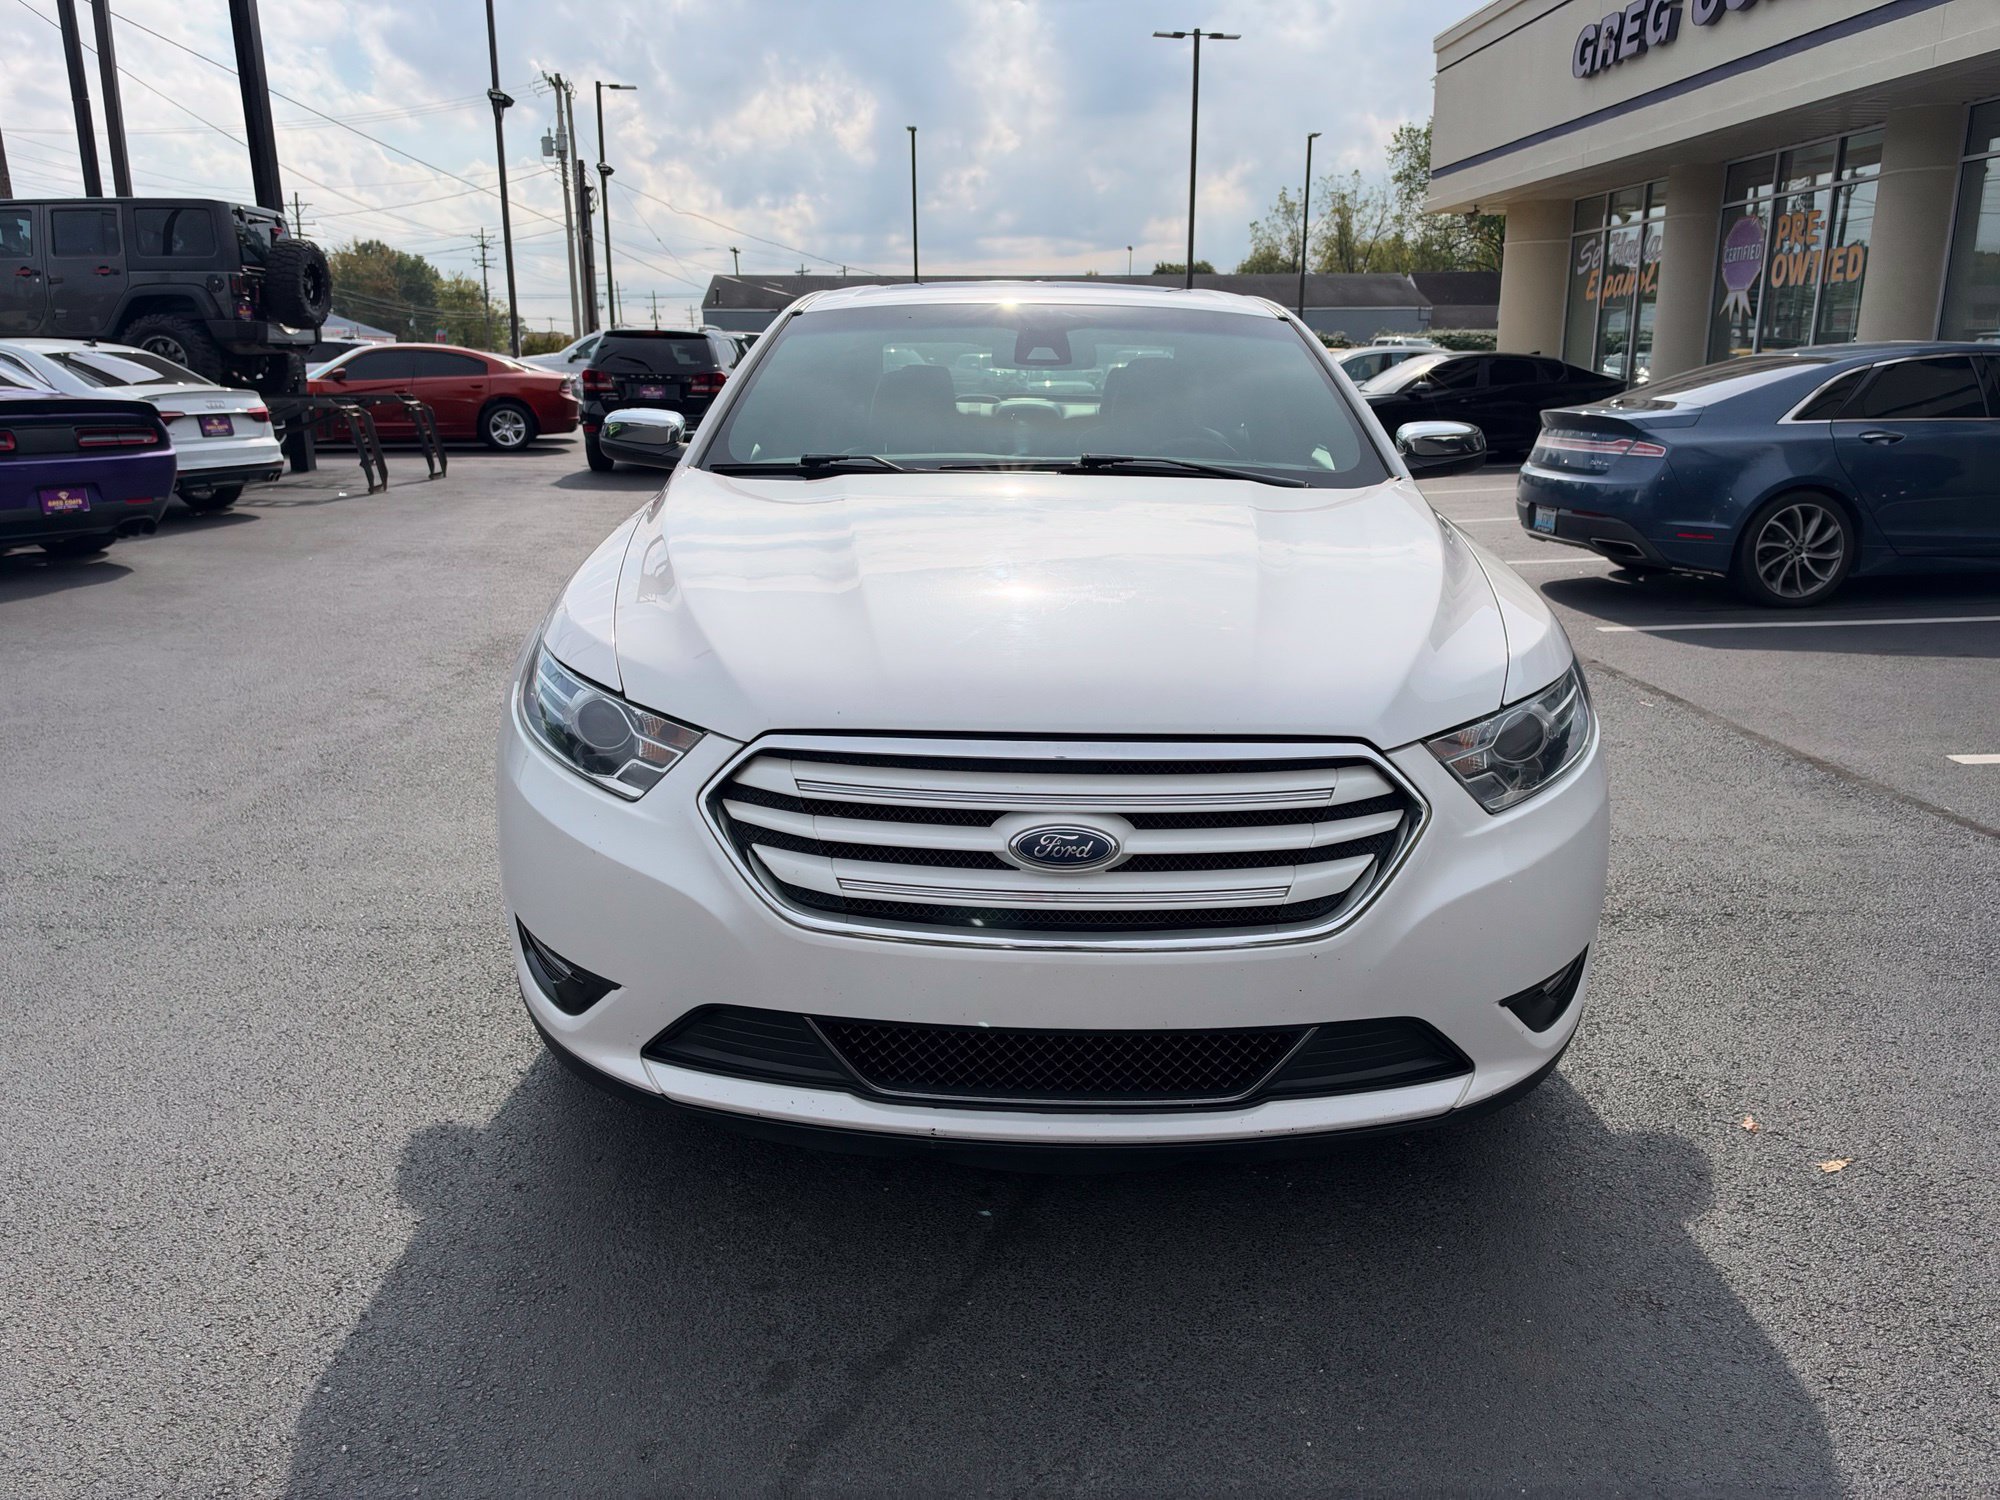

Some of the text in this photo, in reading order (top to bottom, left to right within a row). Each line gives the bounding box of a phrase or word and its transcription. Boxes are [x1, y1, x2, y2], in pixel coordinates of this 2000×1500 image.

[1572, 0, 1681, 78] GREG
[1577, 238, 1602, 275] Se
[1724, 243, 1762, 264] CERTIFIED
[1771, 244, 1864, 289] OWNED
[1034, 834, 1095, 858] Ford
